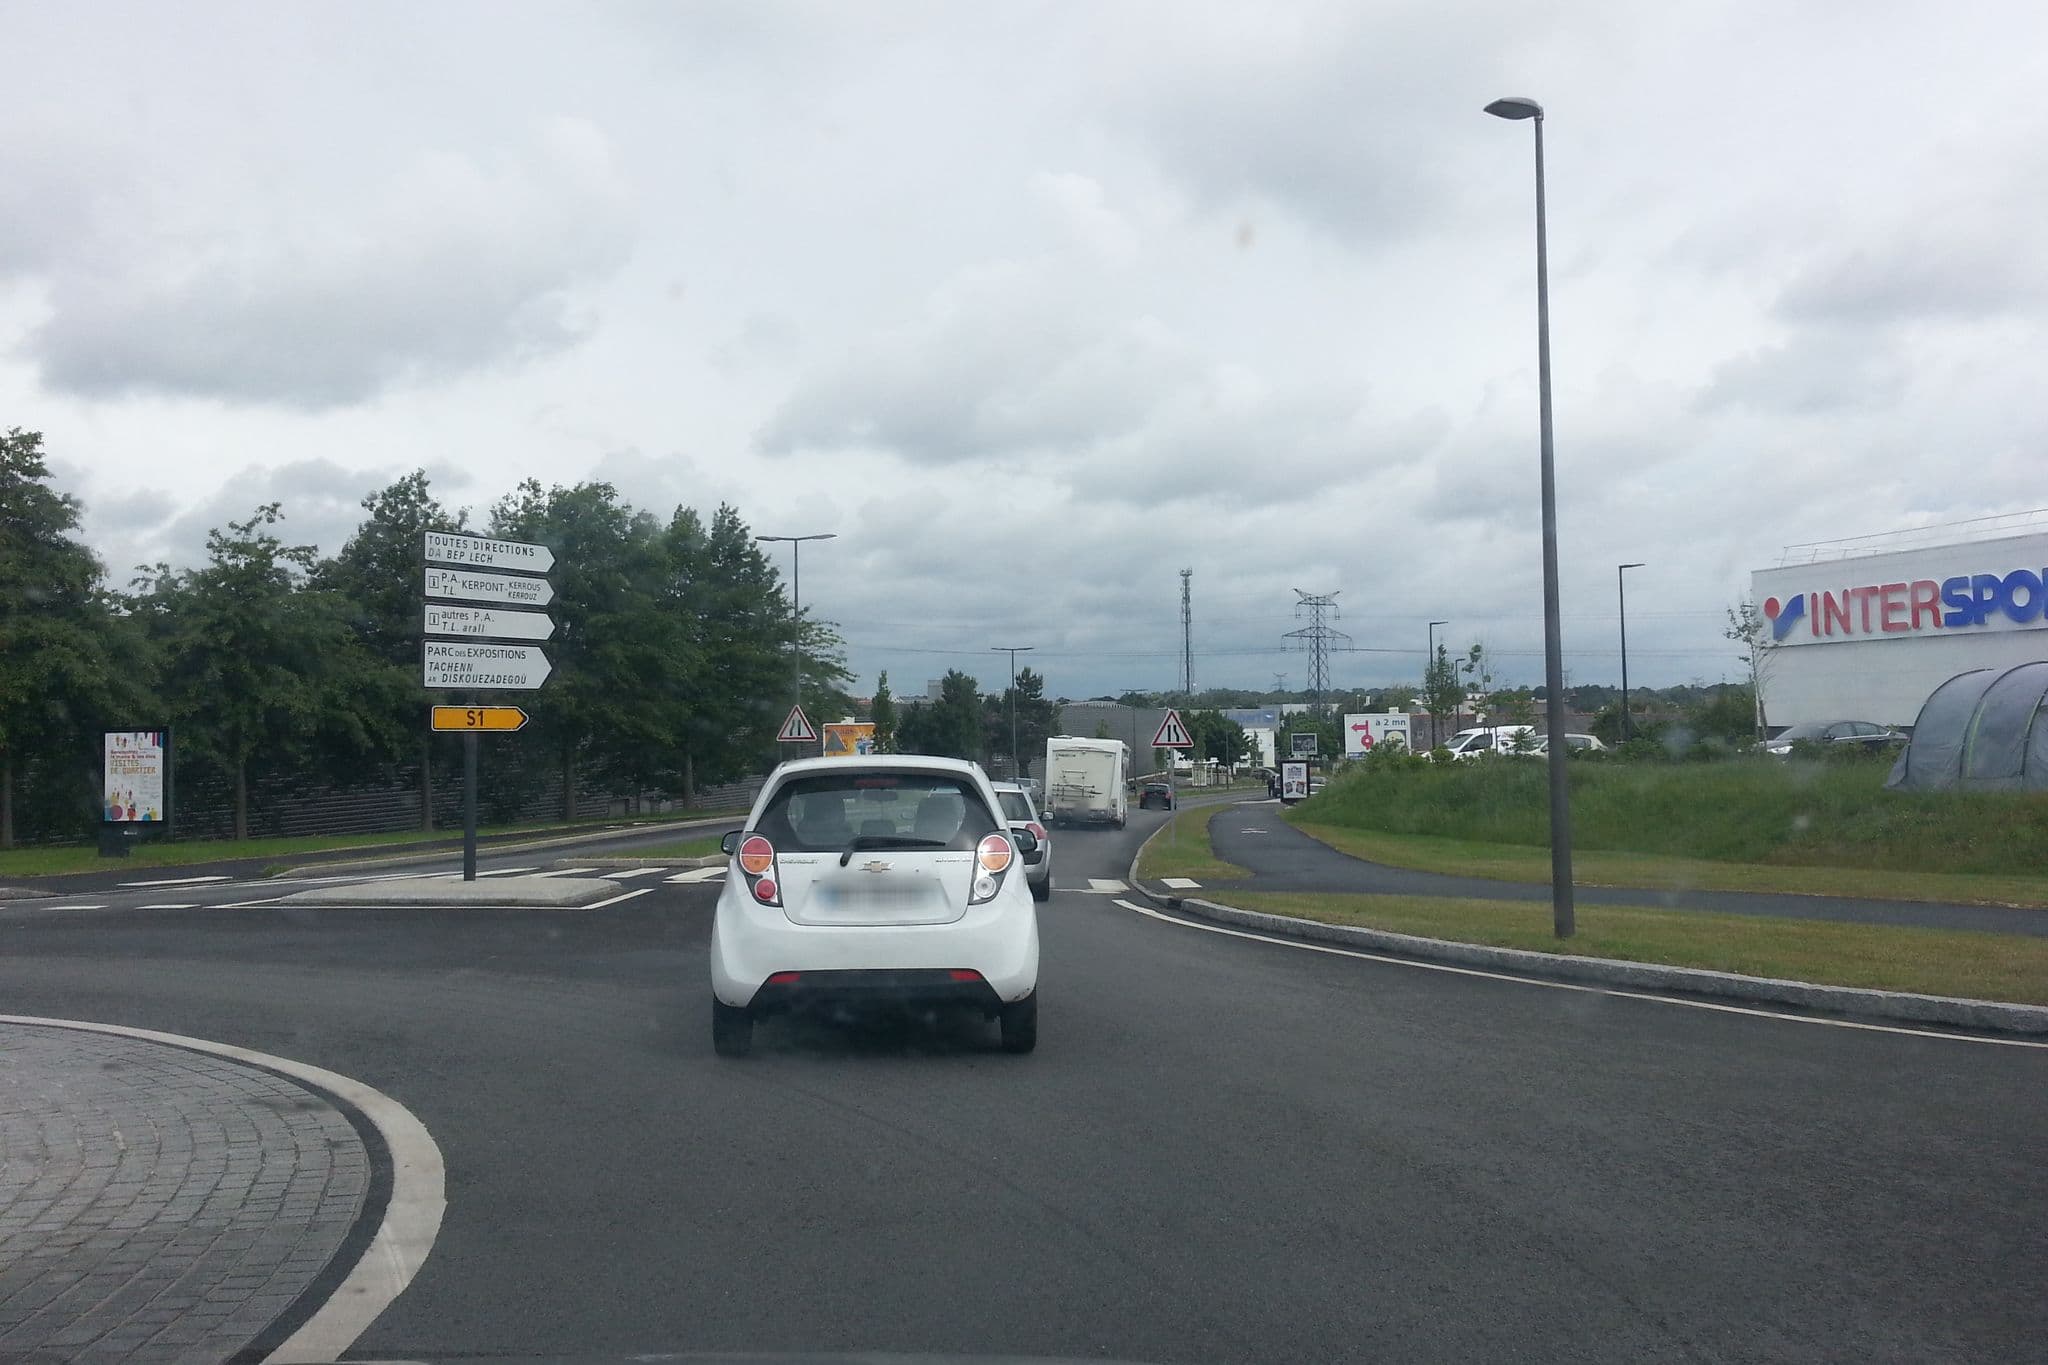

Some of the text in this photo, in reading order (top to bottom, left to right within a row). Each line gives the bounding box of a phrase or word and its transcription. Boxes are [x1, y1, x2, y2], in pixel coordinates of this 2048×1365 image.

[428, 535, 535, 557] TOUTES DIRECTIONS
[428, 547, 441, 558] DA
[447, 549, 465, 561] BEP
[461, 580, 504, 592] KERPONT
[508, 581, 541, 592] KERROUS
[507, 591, 537, 601] KERROUZ
[441, 610, 495, 622] autres P.A.
[462, 624, 485, 633] arall
[427, 646, 454, 657] PARC
[467, 648, 527, 660] EXPOSITIONS
[428, 661, 474, 672] TACHENN
[466, 710, 484, 727] S1
[1383, 718, 1390, 726] 2
